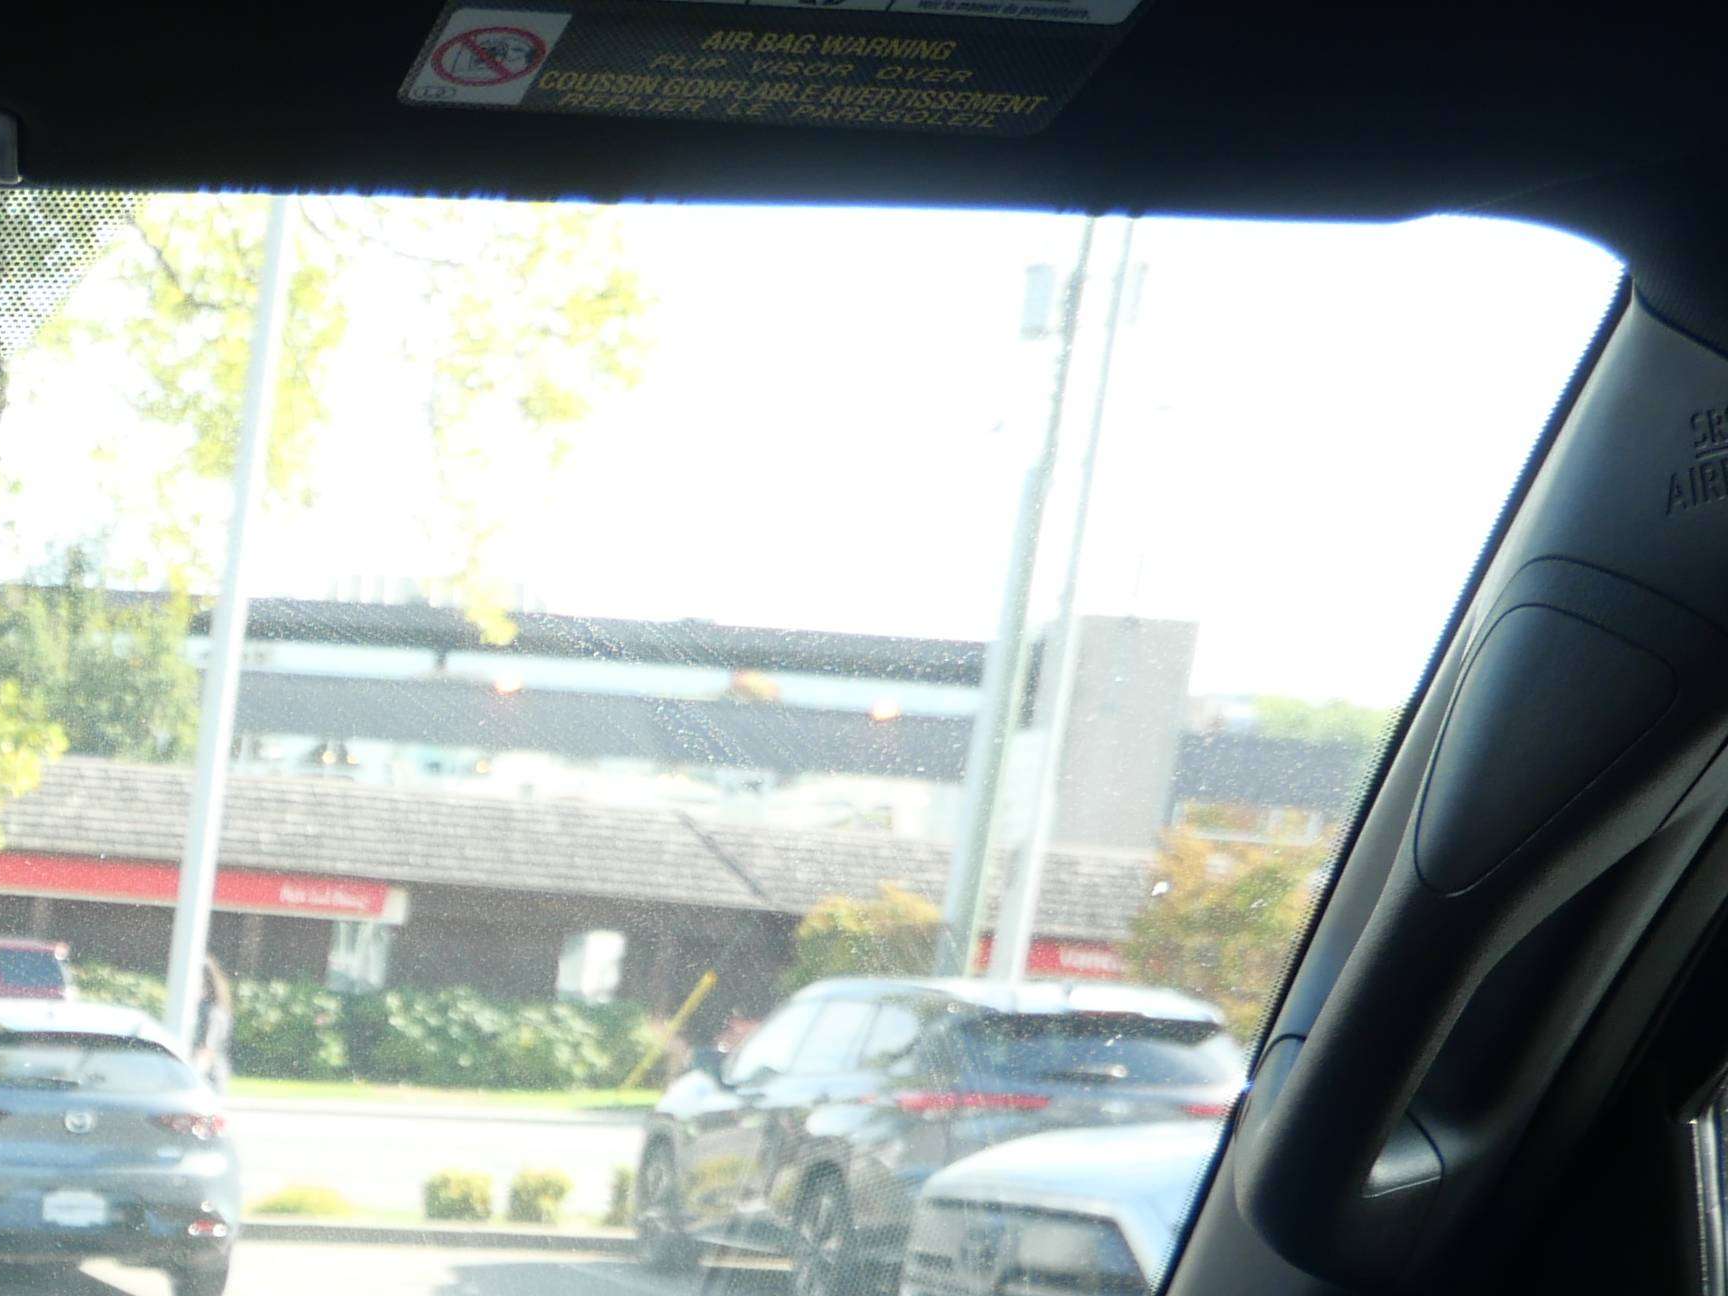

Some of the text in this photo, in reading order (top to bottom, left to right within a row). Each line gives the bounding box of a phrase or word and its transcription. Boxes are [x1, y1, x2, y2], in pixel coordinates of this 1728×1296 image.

[702, 30, 960, 60] AIR BAG WARNING
[649, 53, 976, 83] FLIP VISOR OVER
[538, 70, 661, 96] COUSSIN
[825, 84, 1047, 116] AVERTISSEMENT
[558, 93, 997, 129] REPLIER LE PARESOLEIL
[1689, 406, 1728, 446] SR
